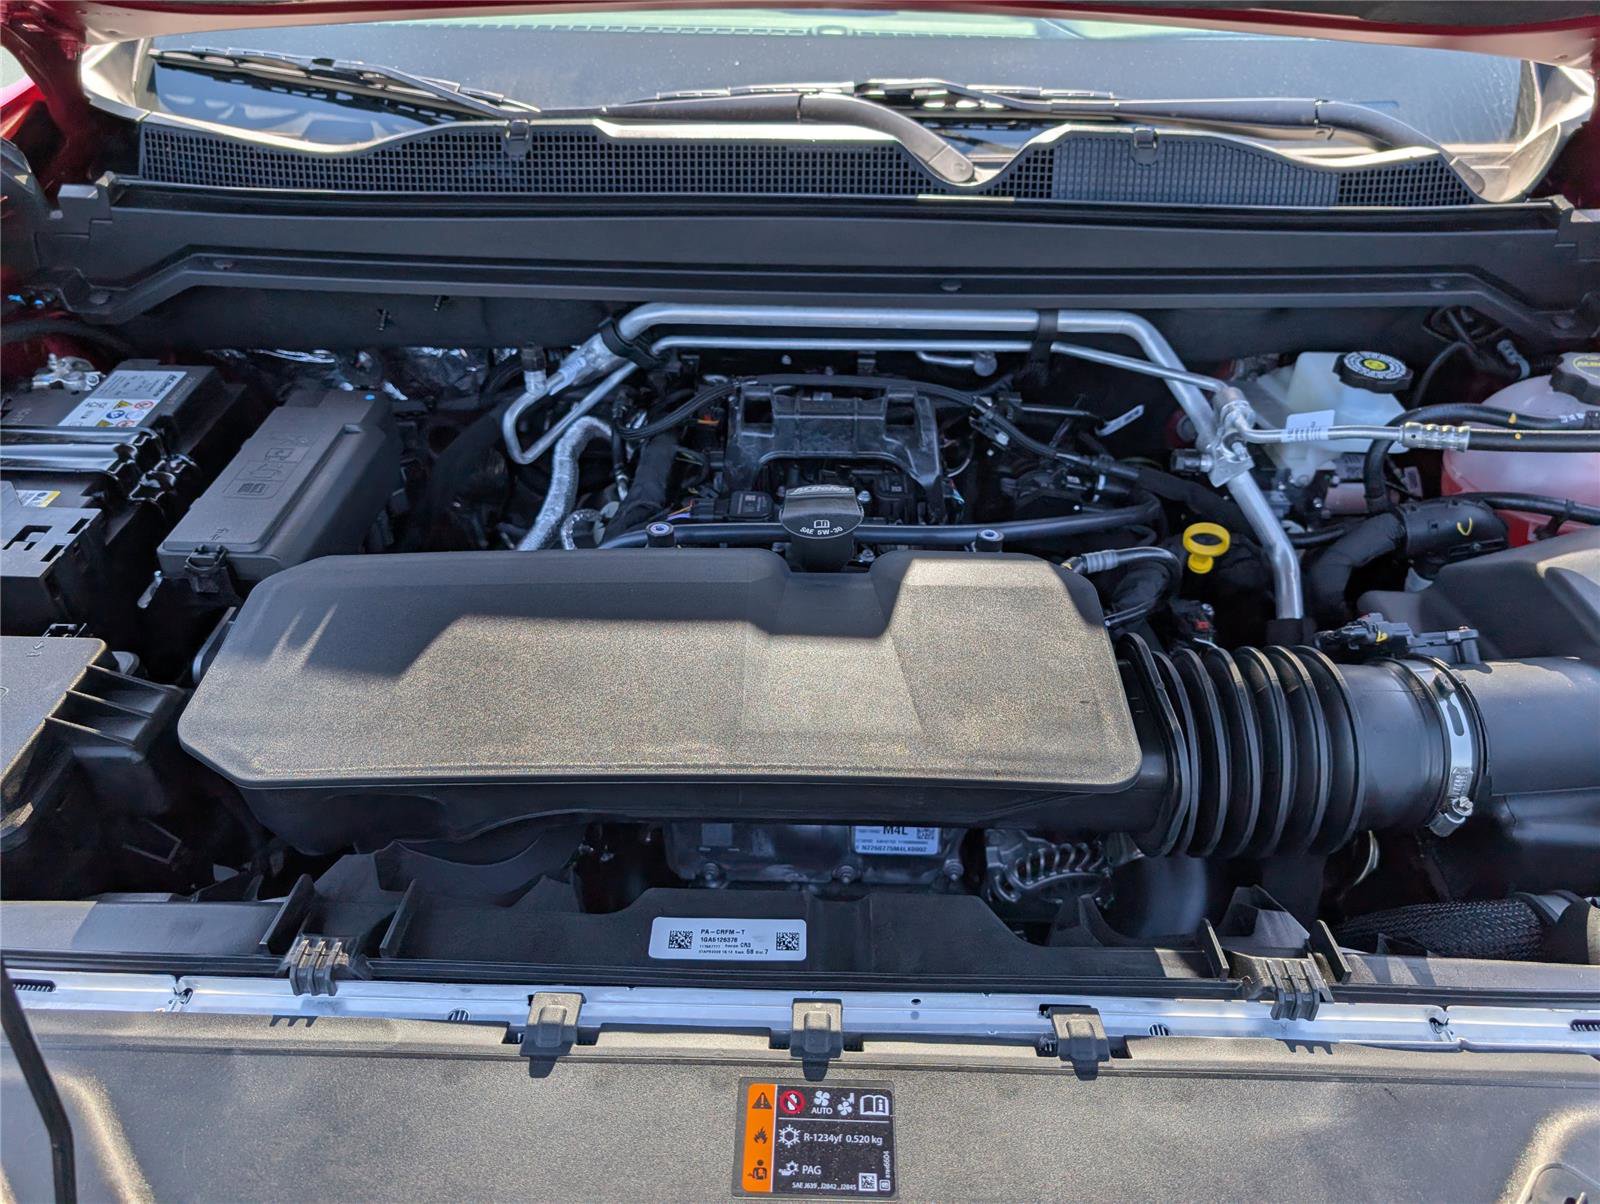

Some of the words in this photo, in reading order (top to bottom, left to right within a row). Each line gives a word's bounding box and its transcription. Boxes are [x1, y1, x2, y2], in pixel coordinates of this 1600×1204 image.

[800, 526, 815, 535] SAE
[817, 526, 844, 535] 5W-30
[811, 1107, 833, 1115] AUTO
[803, 1133, 843, 1144] R-1234yf
[846, 1134, 870, 1144] 0.520
[871, 1135, 883, 1146] kg
[802, 1165, 822, 1175] PAG
